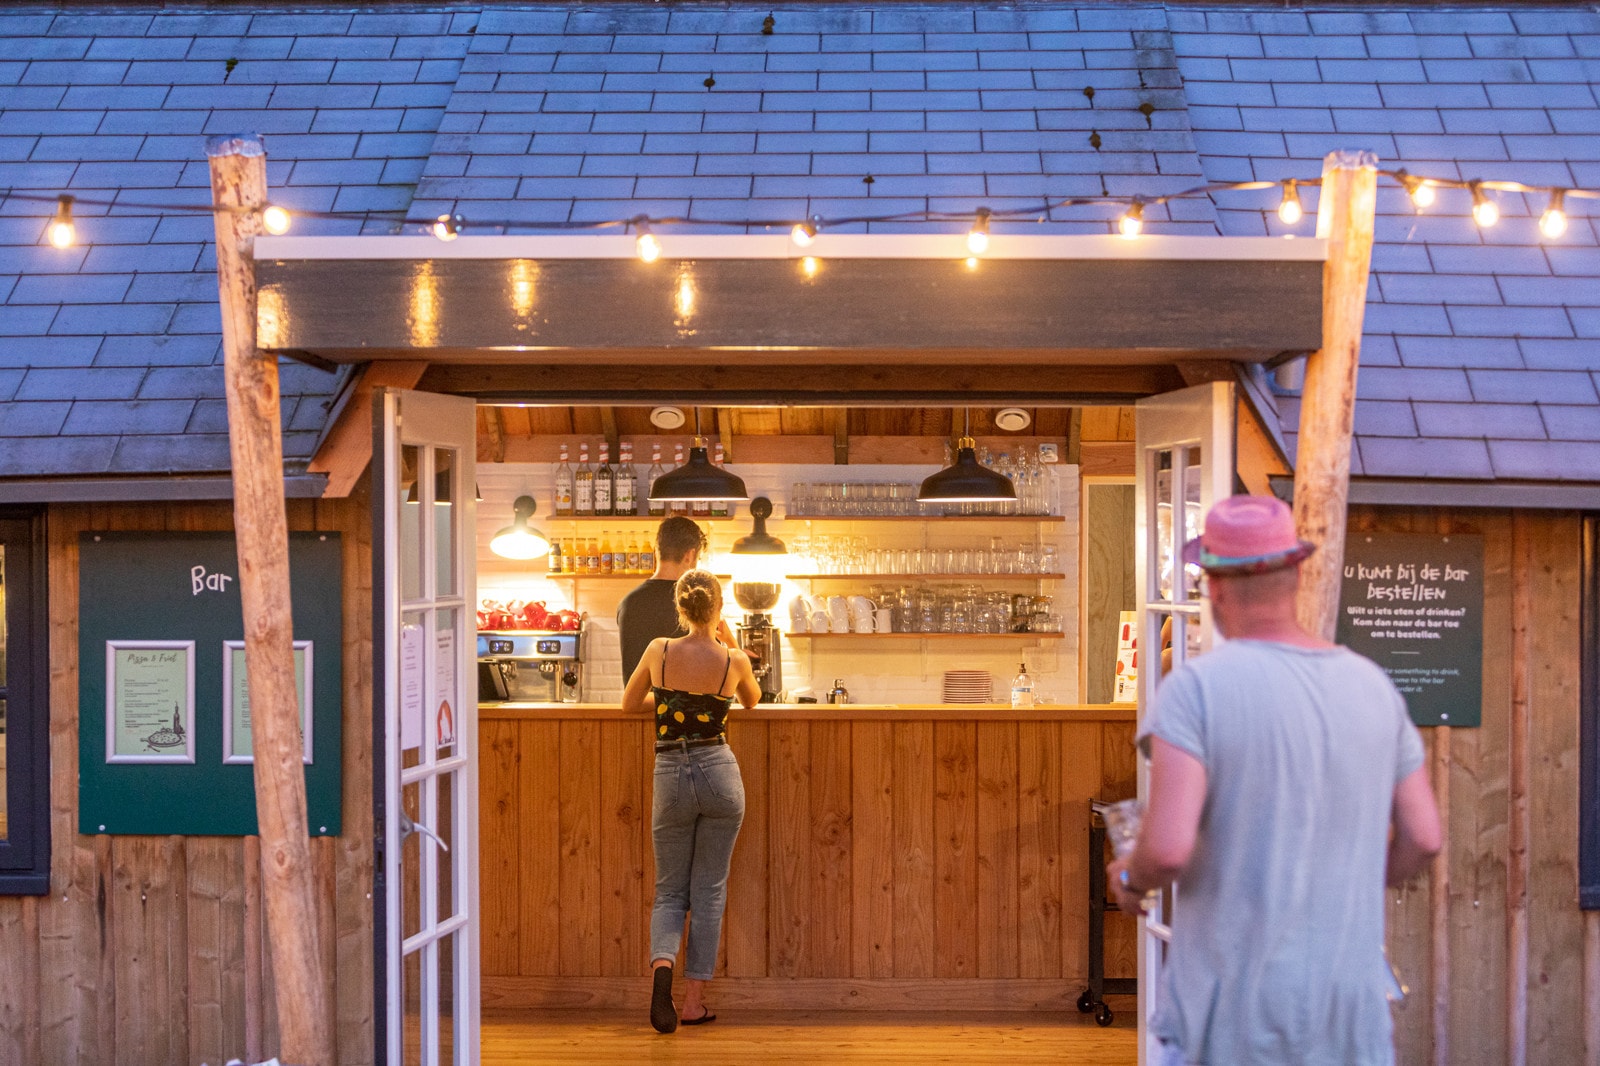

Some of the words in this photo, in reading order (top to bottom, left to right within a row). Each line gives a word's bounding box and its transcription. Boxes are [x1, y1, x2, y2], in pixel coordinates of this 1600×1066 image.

[1397, 563, 1416, 585] bij
[1444, 564, 1470, 581] bar
[191, 565, 232, 596] Bar
[1347, 606, 1366, 615] Wilt
[1375, 606, 1392, 616] iets
[1394, 607, 1414, 616] eten
[1415, 606, 1425, 616] of
[1426, 606, 1466, 617] drinken?
[1353, 618, 1373, 627] Kom
[1374, 618, 1391, 627] dan
[1392, 620, 1412, 628] naar
[1414, 619, 1426, 628] de
[1427, 619, 1442, 628] bar
[1444, 620, 1459, 629] toe
[1370, 630, 1385, 638] om
[1386, 630, 1396, 639] te
[1397, 630, 1441, 640] bestellen.
[1394, 668, 1430, 676] something
